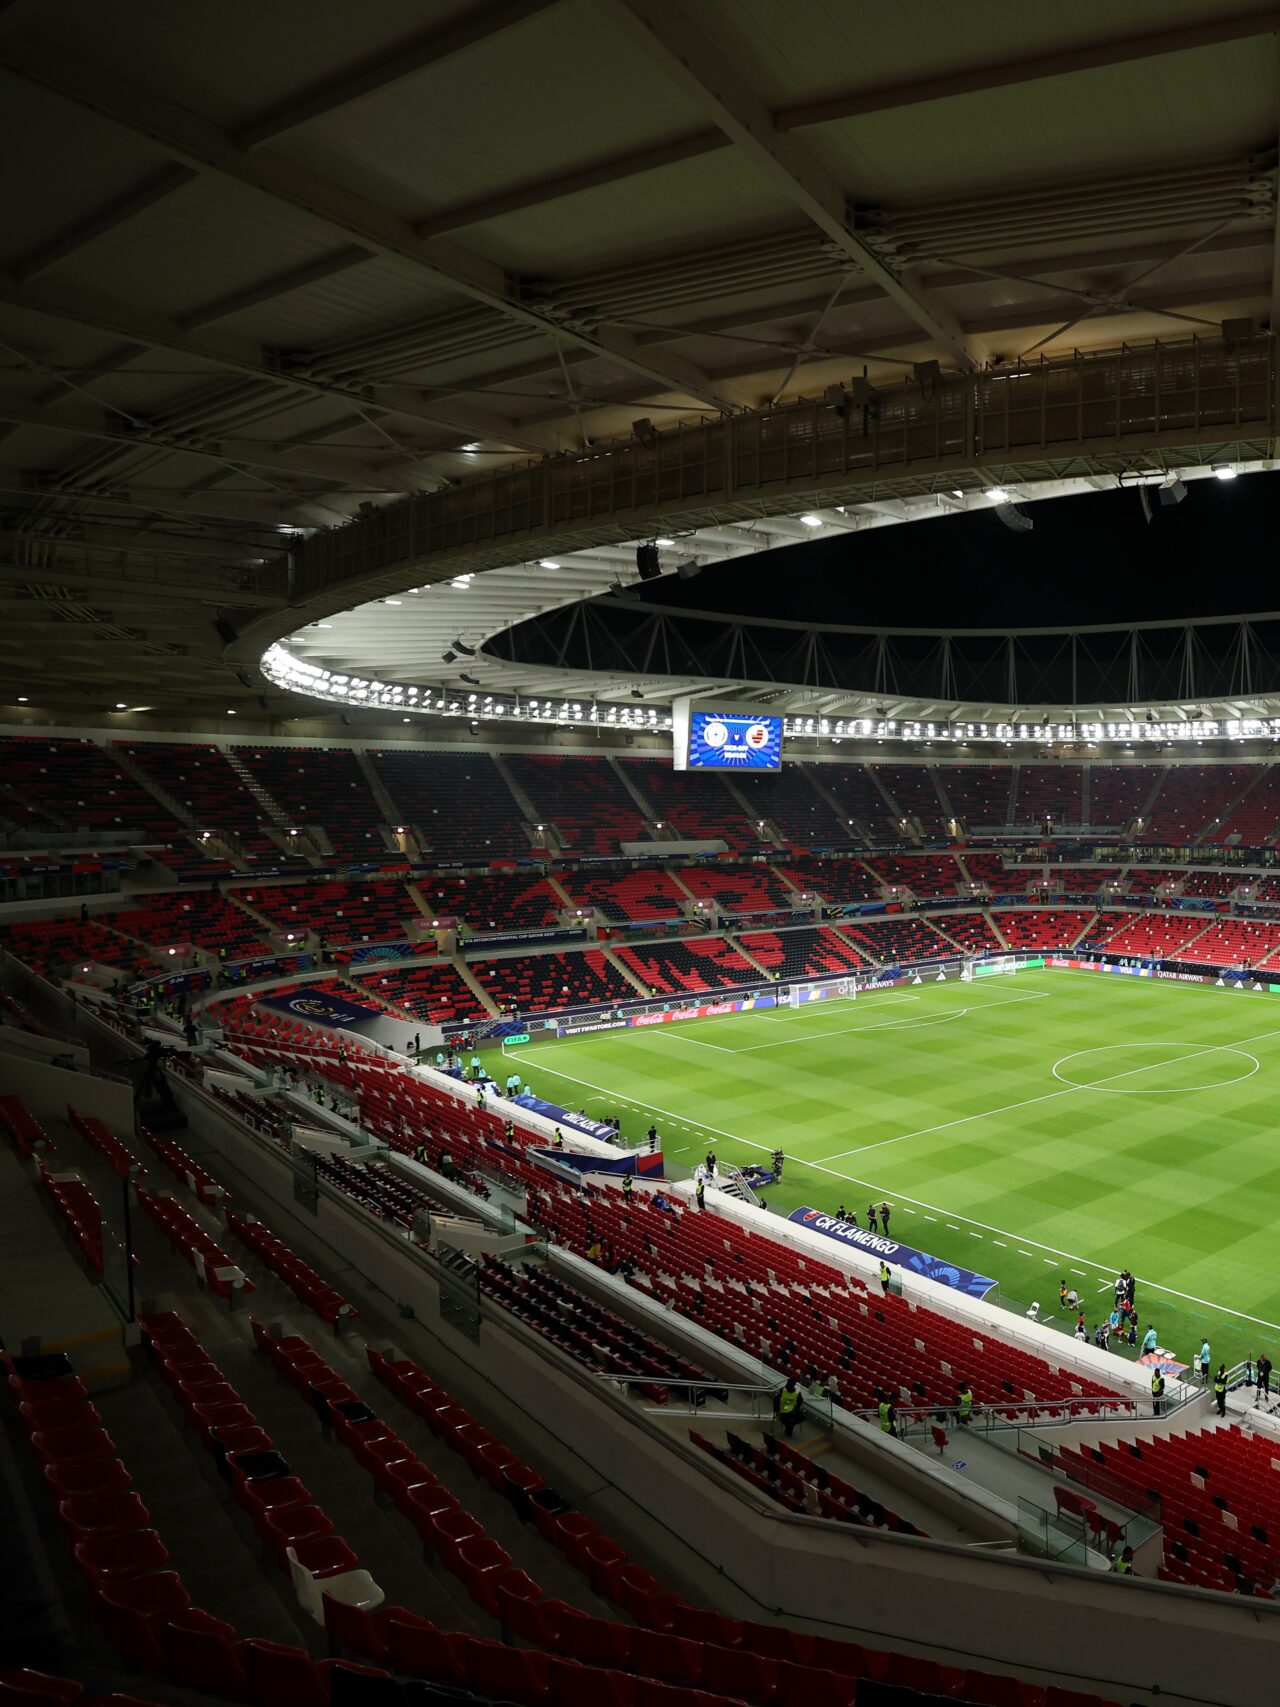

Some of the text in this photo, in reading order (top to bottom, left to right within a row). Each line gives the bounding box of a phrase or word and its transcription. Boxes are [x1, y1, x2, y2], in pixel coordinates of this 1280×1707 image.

[1119, 966, 1133, 974] VISA
[1157, 970, 1203, 982] QATAR AIRWAYS
[864, 979, 894, 990] AIRWAYS
[773, 995, 793, 1005] VISA
[672, 1008, 699, 1021] Coca-Cola
[706, 1003, 732, 1015] Coca-Cola
[636, 1013, 664, 1026] Coca-Cola
[565, 1020, 626, 1035] VISIT FIFASTORE.COM
[815, 1216, 899, 1255] CR FLAMENGO
